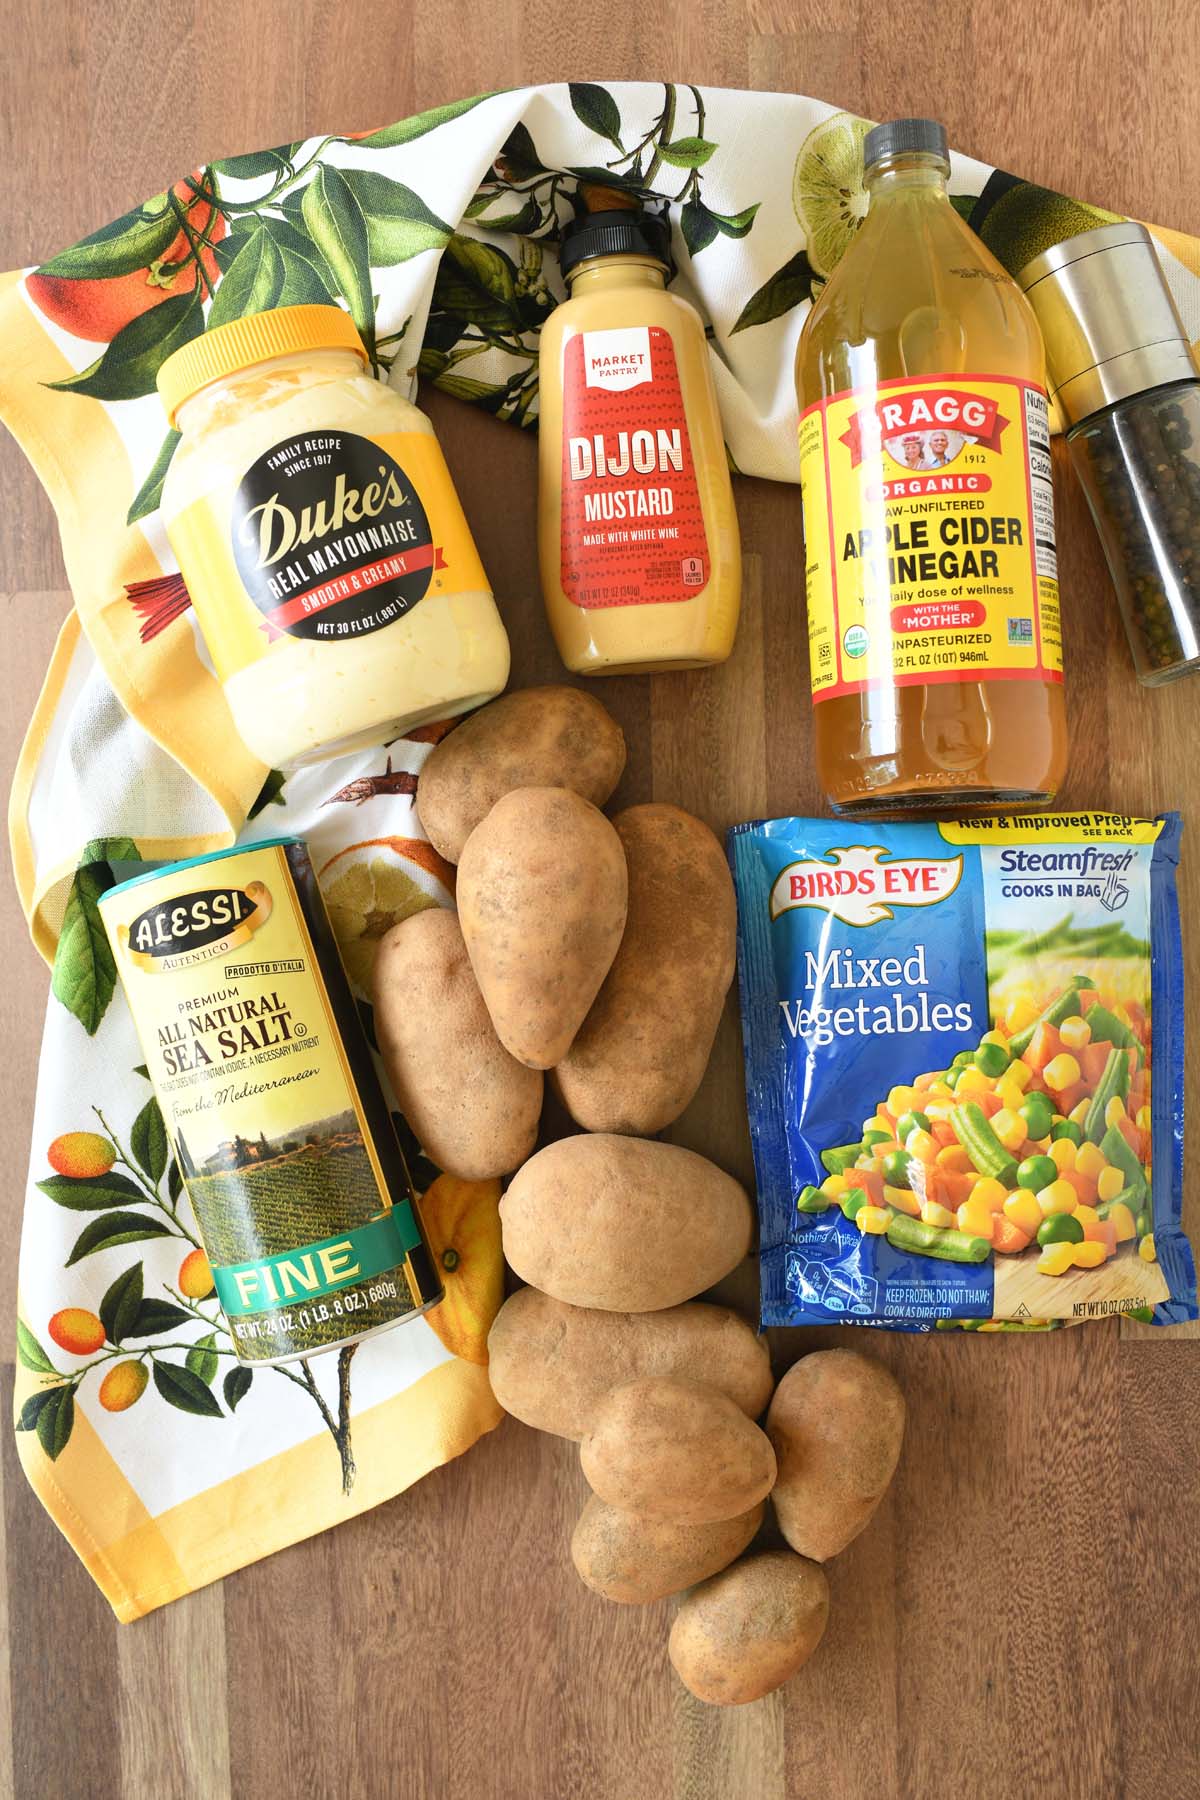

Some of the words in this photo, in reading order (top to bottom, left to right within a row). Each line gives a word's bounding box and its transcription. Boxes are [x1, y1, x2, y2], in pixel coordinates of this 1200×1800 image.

[591, 353, 645, 370] MARKET
[599, 367, 639, 377] PANTRY
[868, 396, 986, 432] RAGG
[267, 443, 301, 471] FAMILY
[304, 438, 342, 452] RECIPE
[285, 458, 312, 477] SINCE
[313, 455, 332, 465] 1917
[569, 429, 683, 481] DIJON
[964, 455, 986, 464] 1912
[238, 465, 408, 570] Duke's
[584, 487, 674, 522] MUSTARD
[885, 500, 985, 517] AW-UNFILTERED
[583, 534, 606, 546] MADE
[607, 531, 629, 544] WITH
[630, 529, 656, 542] WHITE
[658, 527, 680, 539] WINE
[940, 517, 1023, 547] CIDER
[266, 563, 310, 600] REAL
[307, 519, 417, 575] MAYONNAISE
[690, 560, 696, 571] 0
[872, 550, 999, 585] INEGAR
[301, 579, 349, 613] SMOOTH
[352, 575, 362, 590] &
[363, 556, 408, 584] CREAMY
[917, 588, 947, 599] dose
[951, 586, 962, 596] of
[966, 584, 1014, 596] wellness
[913, 605, 940, 614] WITH
[942, 604, 960, 613] THE
[317, 623, 335, 634] NET
[337, 623, 349, 634] 30
[351, 620, 362, 633] FL
[362, 616, 376, 629] OZ
[906, 655, 916, 667] FL
[919, 654, 930, 666] OZ
[959, 650, 988, 662] 946mL
[959, 817, 993, 829] New
[998, 817, 1010, 829] &
[1014, 814, 1091, 831] Improved
[1094, 815, 1132, 830] Prep
[1000, 847, 1133, 876] Steamfresh
[789, 868, 876, 901] BIRDS
[884, 866, 940, 893] EYE
[1002, 885, 1054, 898] COOKS
[1057, 885, 1073, 897] IN
[1076, 885, 1100, 897] BAG
[136, 892, 242, 950] ALESSI
[162, 942, 229, 970] AUTENTICO
[227, 965, 270, 978] PRODOTTO
[272, 961, 303, 973] D'ITALIA
[804, 944, 929, 990] Mixed
[178, 987, 240, 1014] PREMIUM
[157, 1022, 187, 1047] ALL
[188, 992, 286, 1037] NATURAL
[779, 992, 972, 1045] Vegetables
[163, 1039, 213, 1076] SEA
[218, 1011, 293, 1059] SALT
[226, 1060, 249, 1075] IODIDE,
[250, 1057, 255, 1067] A
[255, 1045, 291, 1065] NECESSARY
[292, 1036, 320, 1053] NUTRIENT
[195, 1096, 214, 1112] the
[215, 1067, 320, 1106] Mediterranean
[791, 1231, 828, 1244] Nothing
[232, 1240, 361, 1308] FINE
[235, 1323, 248, 1339] NET
[266, 1318, 279, 1334] 24
[280, 1315, 298, 1332] OZ.
[300, 1311, 310, 1330] (1
[313, 1305, 333, 1322] LB.
[335, 1299, 343, 1316] 8
[346, 1293, 369, 1313] OZ.)
[369, 1282, 397, 1303] 680g
[886, 1288, 904, 1304] KEEP
[905, 1288, 935, 1304] FROZEN;
[937, 1289, 948, 1304] DO
[949, 1289, 964, 1304] NOT
[964, 1290, 990, 1305] THAW;
[1073, 1302, 1086, 1317] NET
[1087, 1302, 1100, 1316] WT
[1100, 1302, 1107, 1315] 10
[1109, 1300, 1118, 1314] OZ
[884, 1306, 906, 1317] COOK
[906, 1306, 915, 1318] AS
[916, 1306, 952, 1319] DIRECTED
